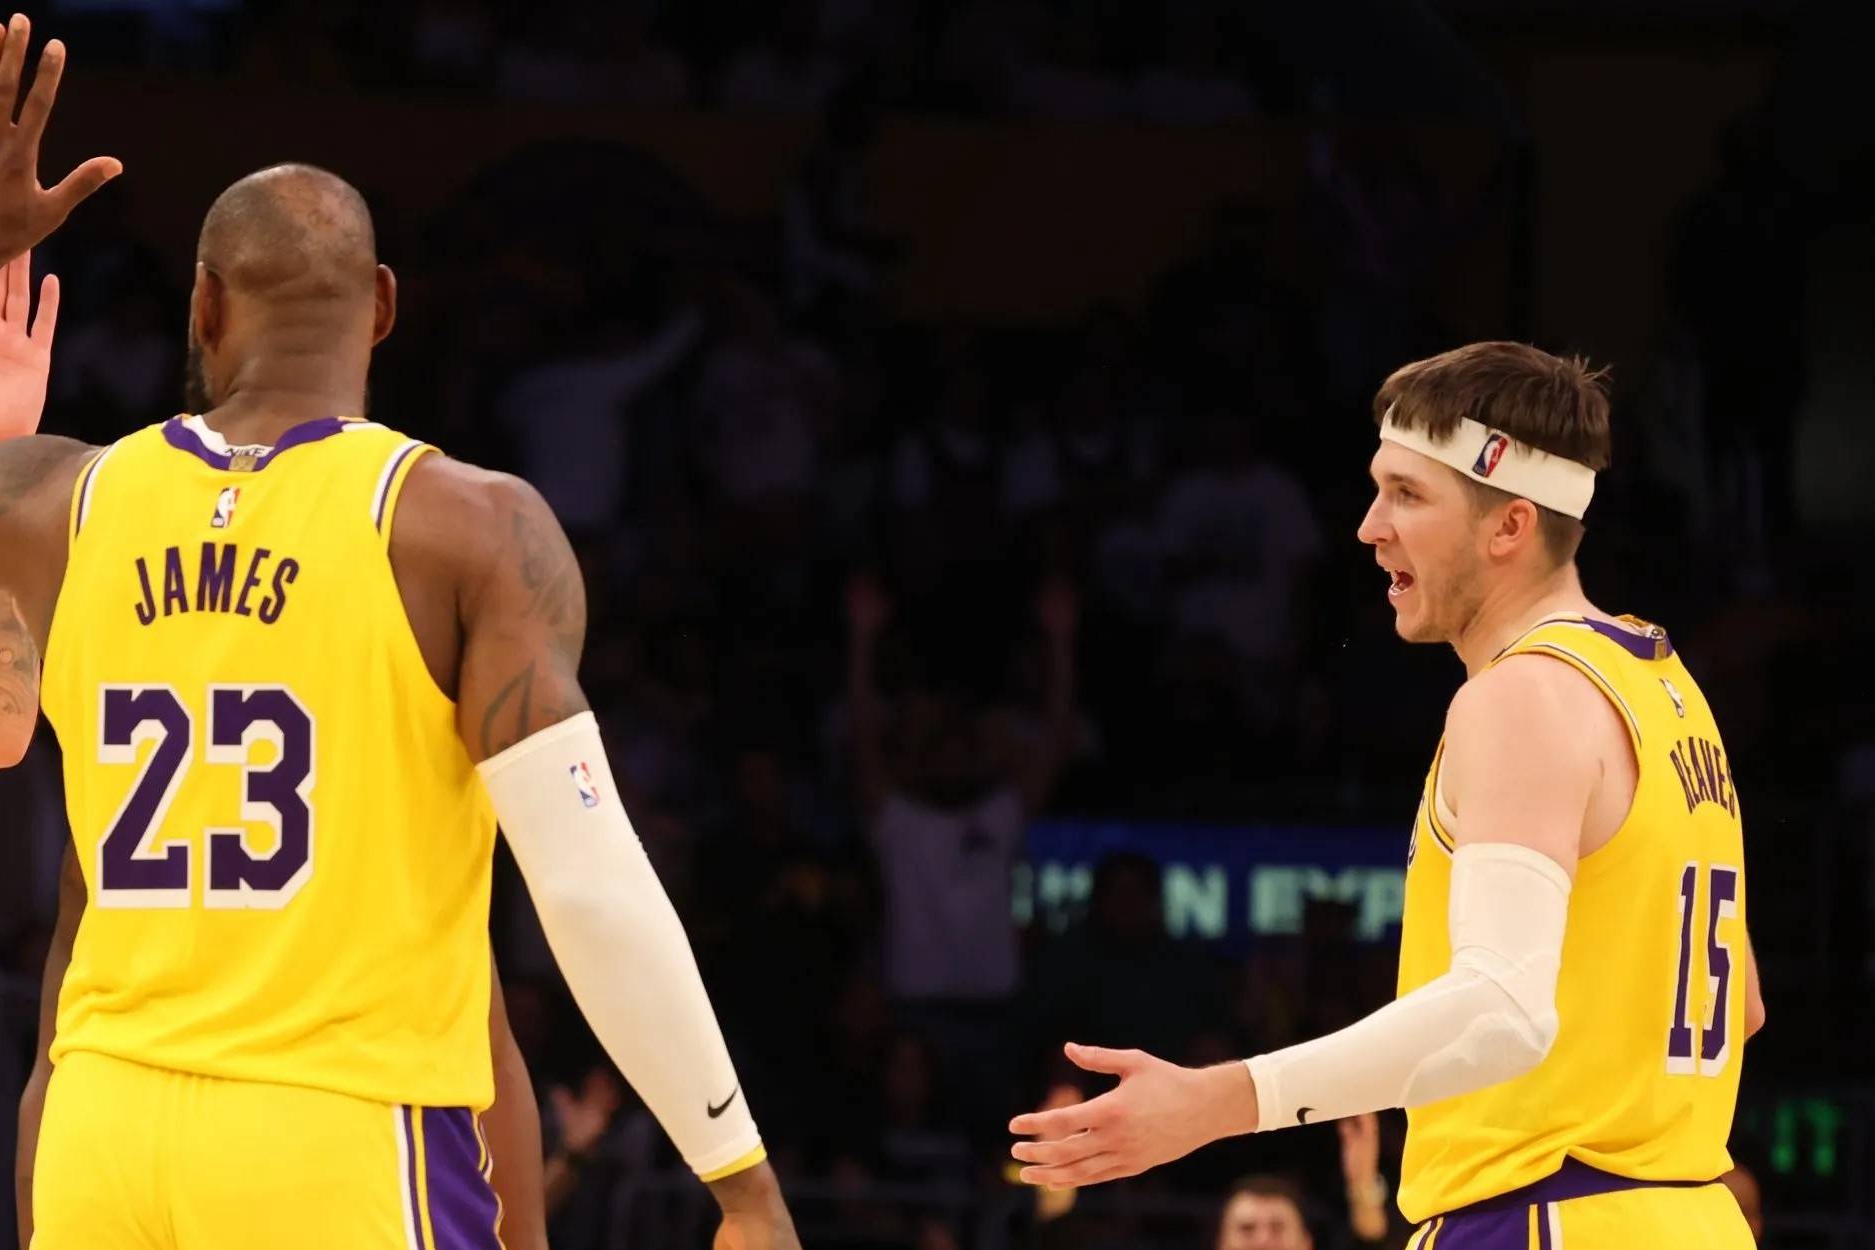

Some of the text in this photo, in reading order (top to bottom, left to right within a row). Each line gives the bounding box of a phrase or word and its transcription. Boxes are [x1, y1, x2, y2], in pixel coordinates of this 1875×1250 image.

[133, 541, 300, 626] JAMES
[95, 682, 316, 910] 23
[1665, 861, 1739, 1078] 15
